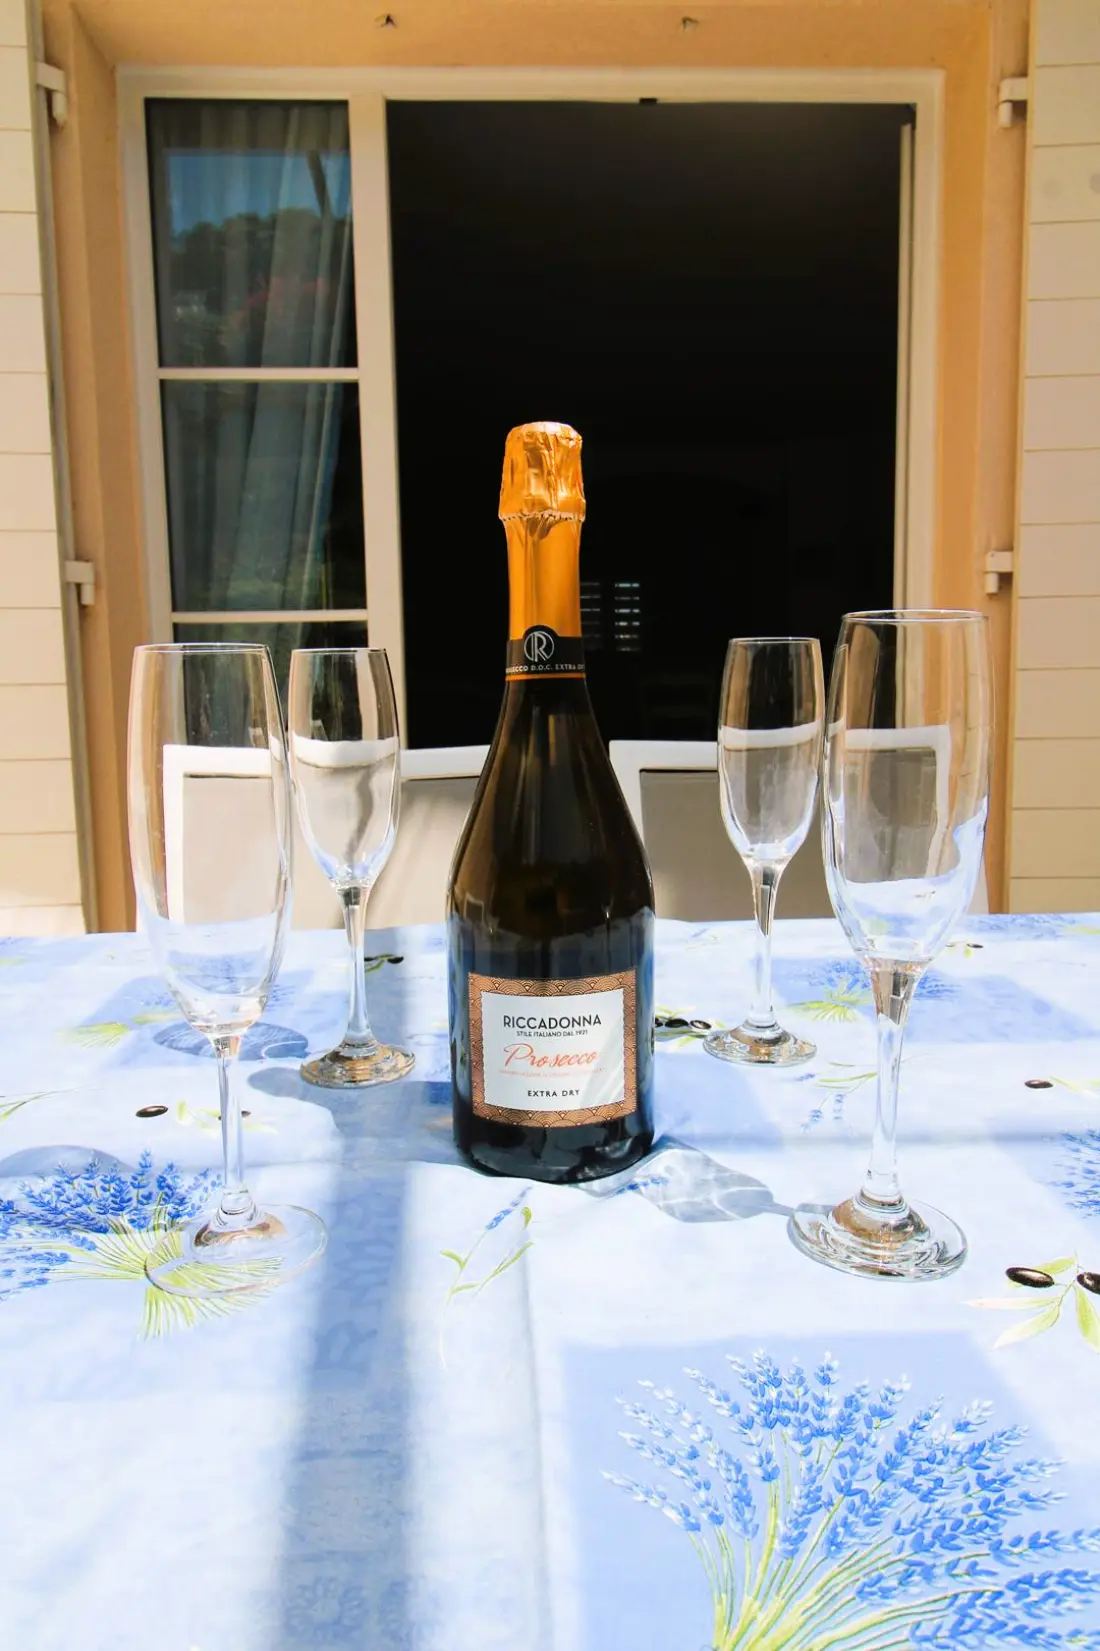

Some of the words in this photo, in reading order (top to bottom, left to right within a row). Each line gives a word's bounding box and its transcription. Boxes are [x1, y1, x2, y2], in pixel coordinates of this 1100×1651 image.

[503, 1014, 602, 1029] RICCADONNA
[503, 1042, 599, 1067] Prosecco
[527, 1089, 558, 1097] EXTRA
[561, 1089, 580, 1097] DRY
